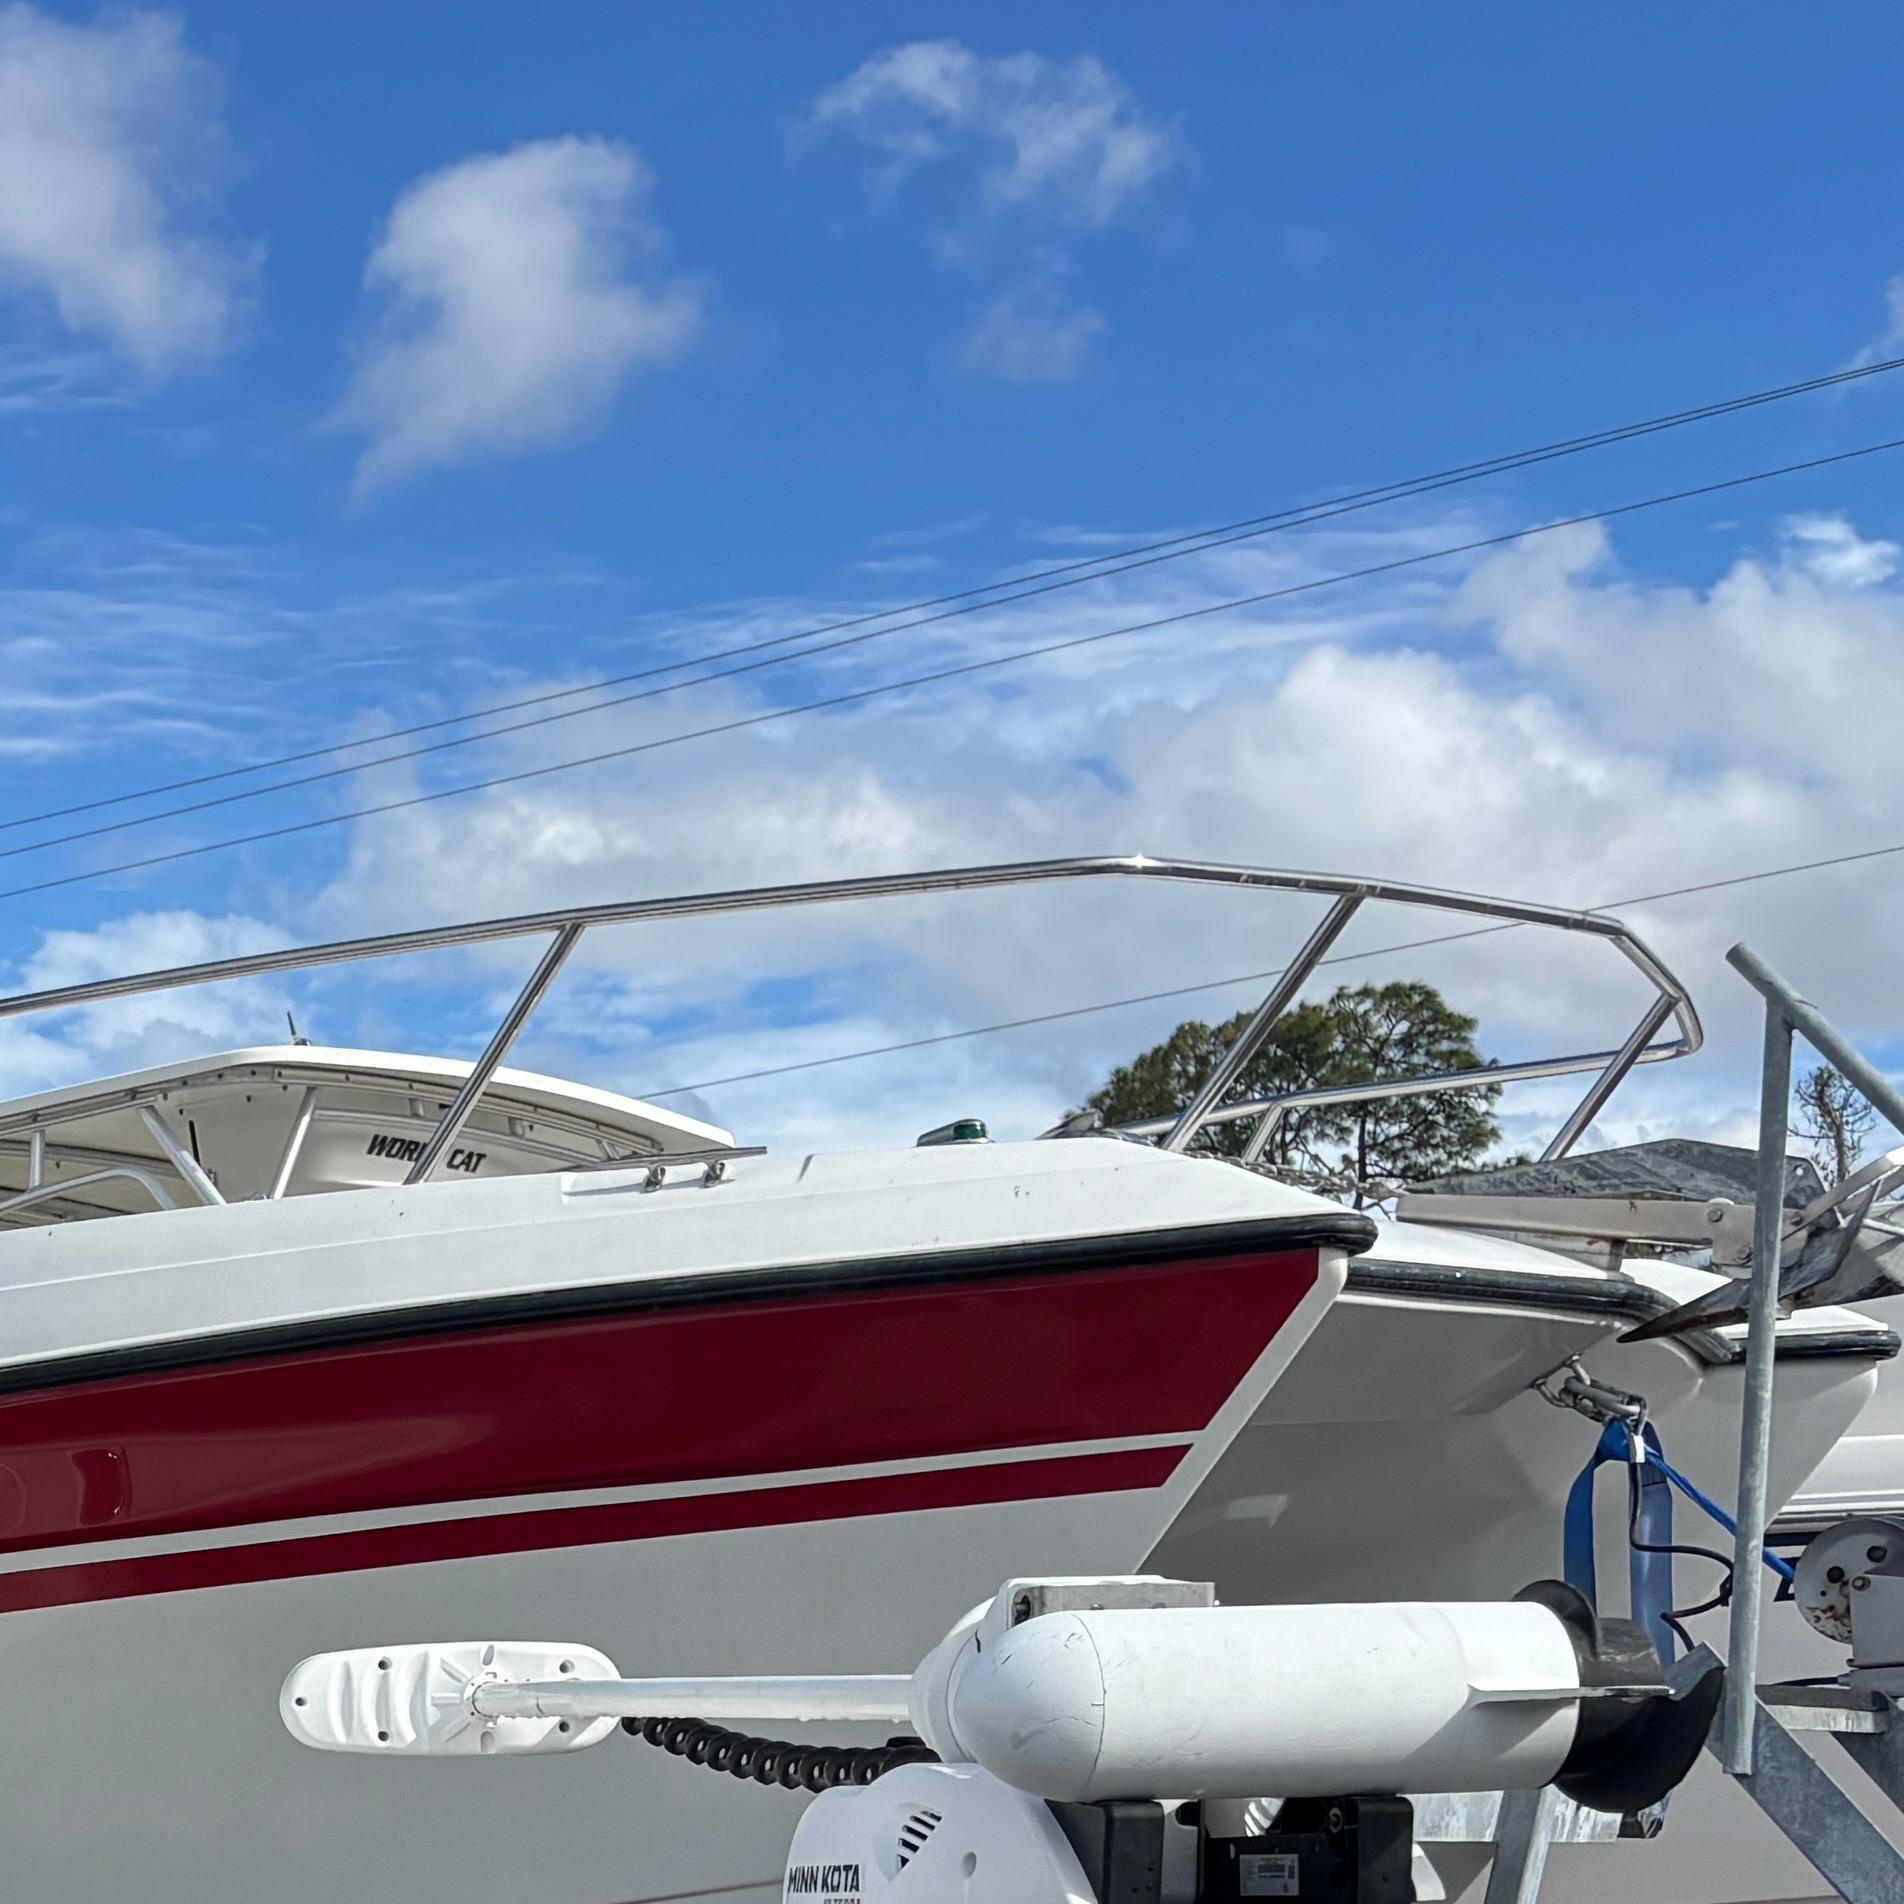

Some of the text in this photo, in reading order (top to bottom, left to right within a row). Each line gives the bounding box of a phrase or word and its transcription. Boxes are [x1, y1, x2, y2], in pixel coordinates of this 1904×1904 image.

[446, 1148, 488, 1174] CAT
[787, 1864, 860, 1894] MINN KOTA
